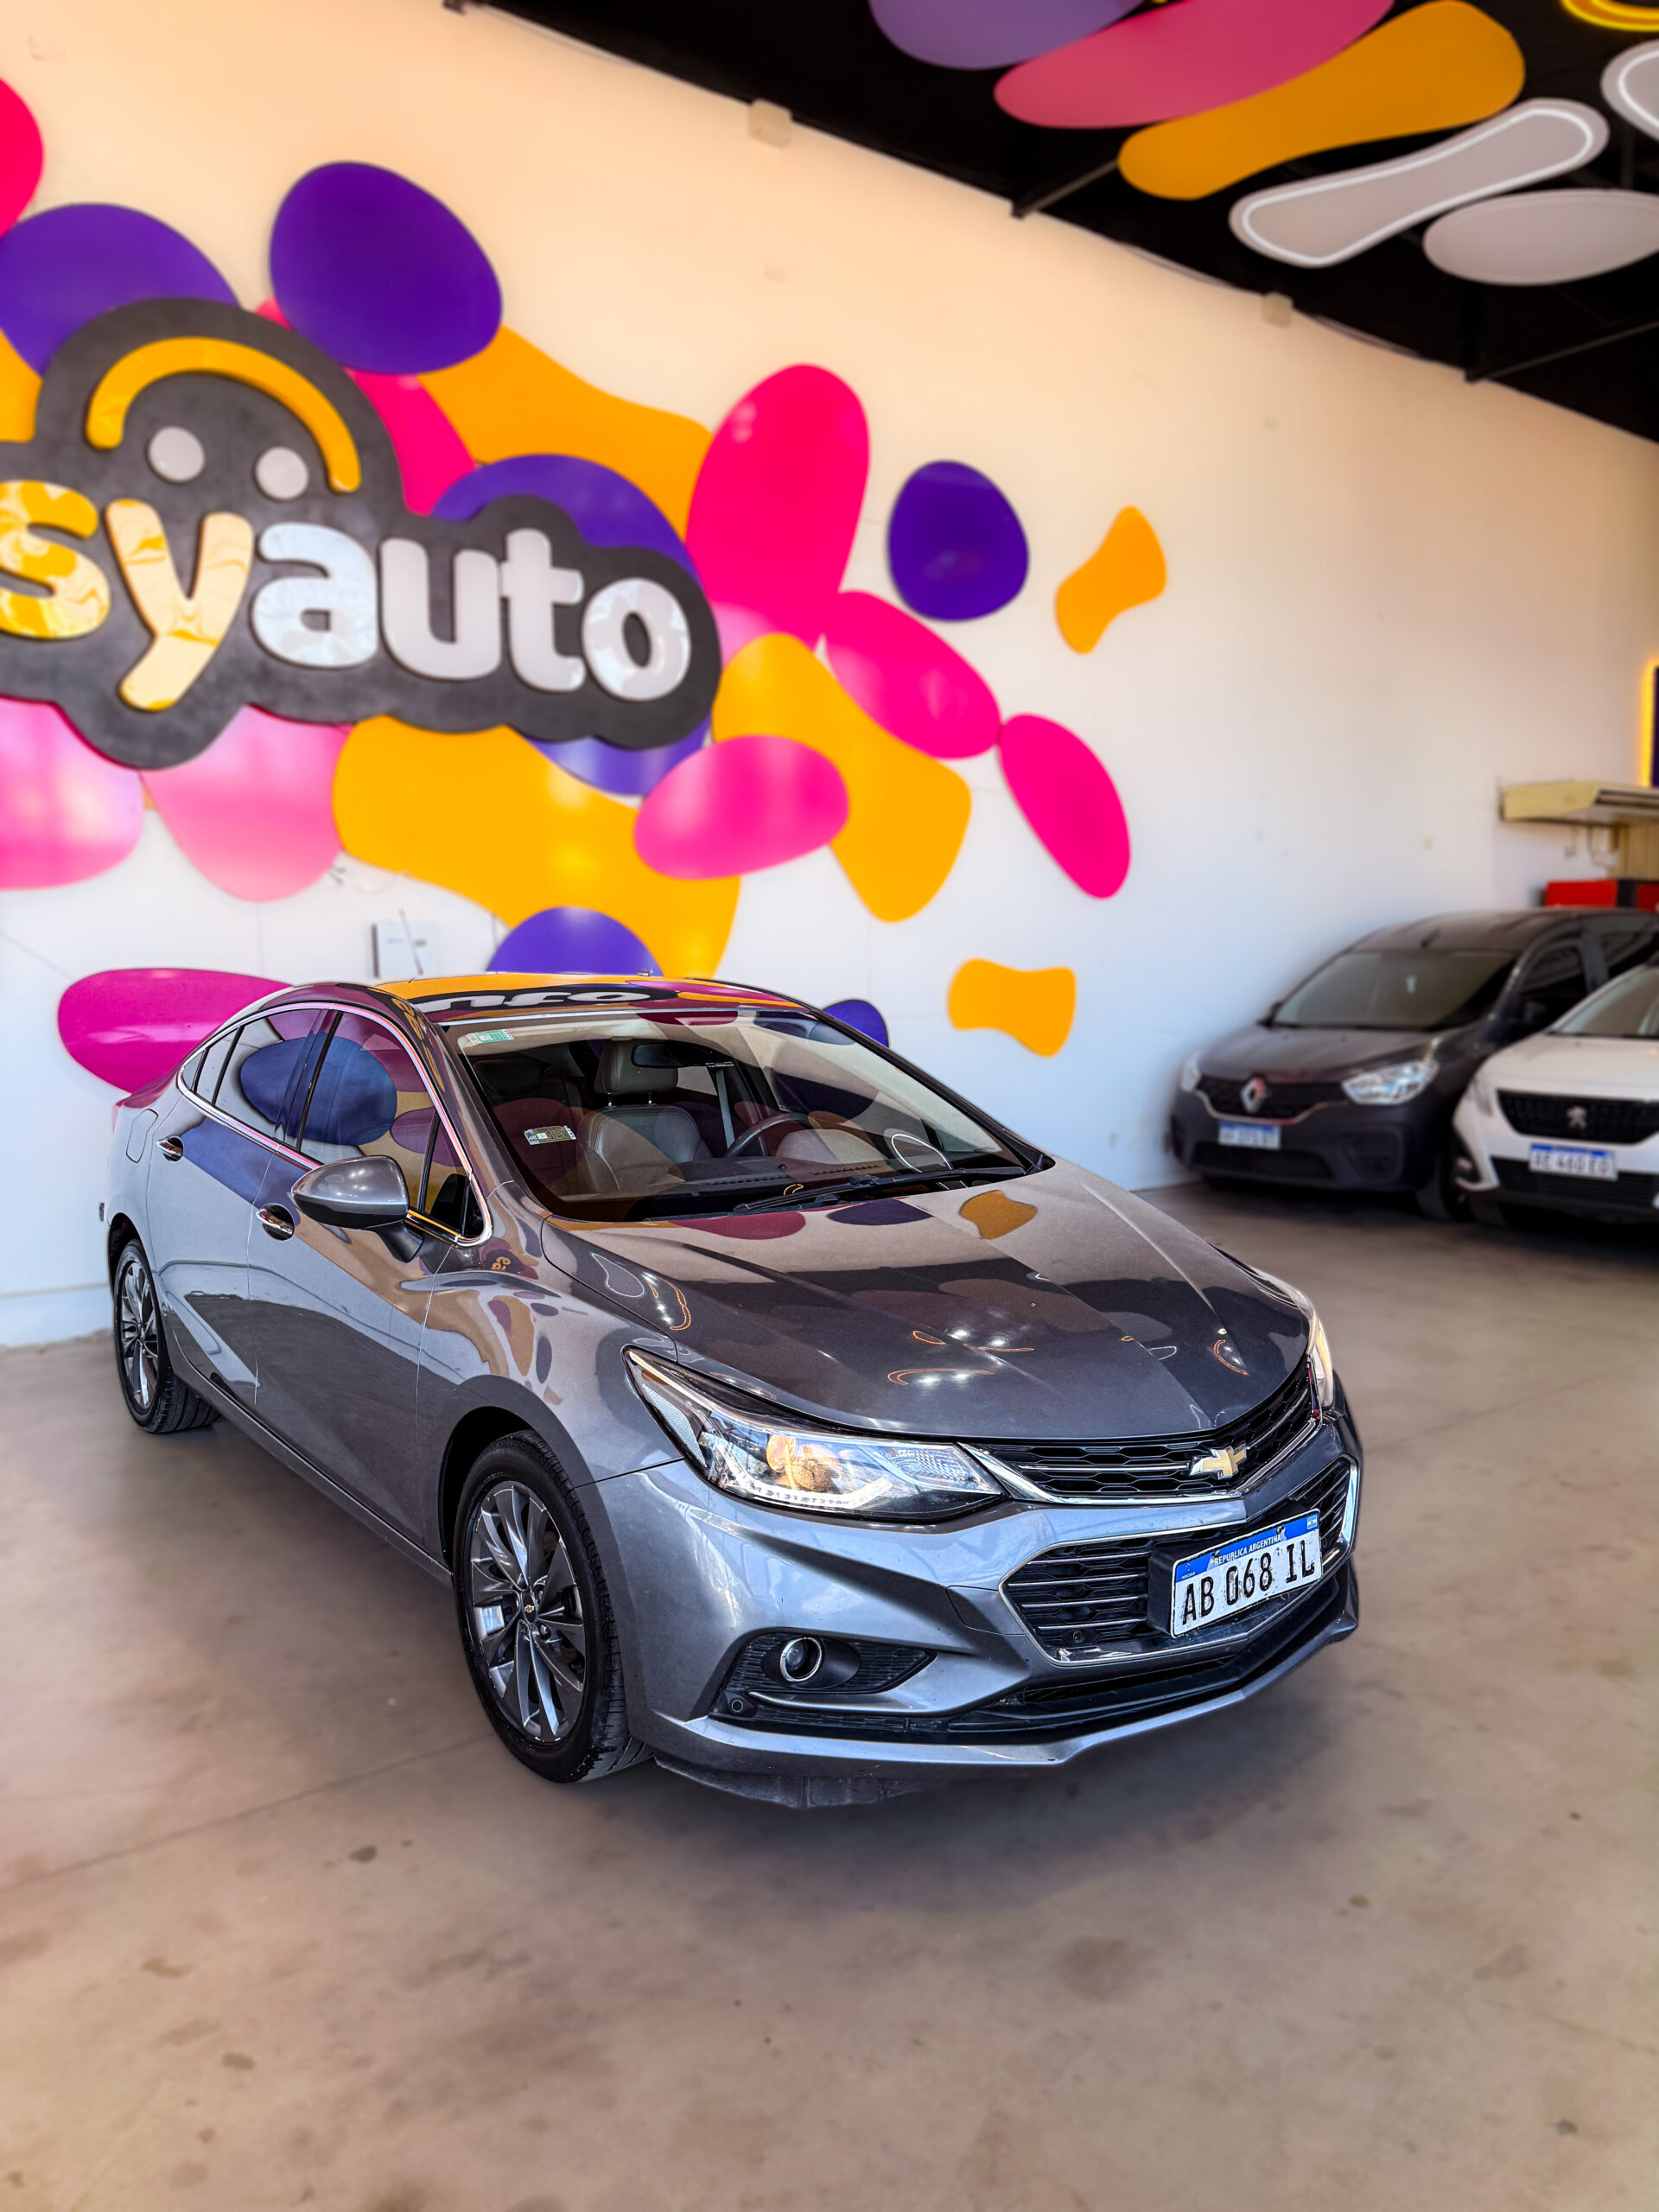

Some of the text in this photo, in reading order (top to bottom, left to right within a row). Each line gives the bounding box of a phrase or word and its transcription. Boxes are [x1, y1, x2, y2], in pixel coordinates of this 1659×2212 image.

[1249, 1534, 1281, 1554] ARGENTINA
[1182, 1540, 1316, 1625] AB 068 IL
